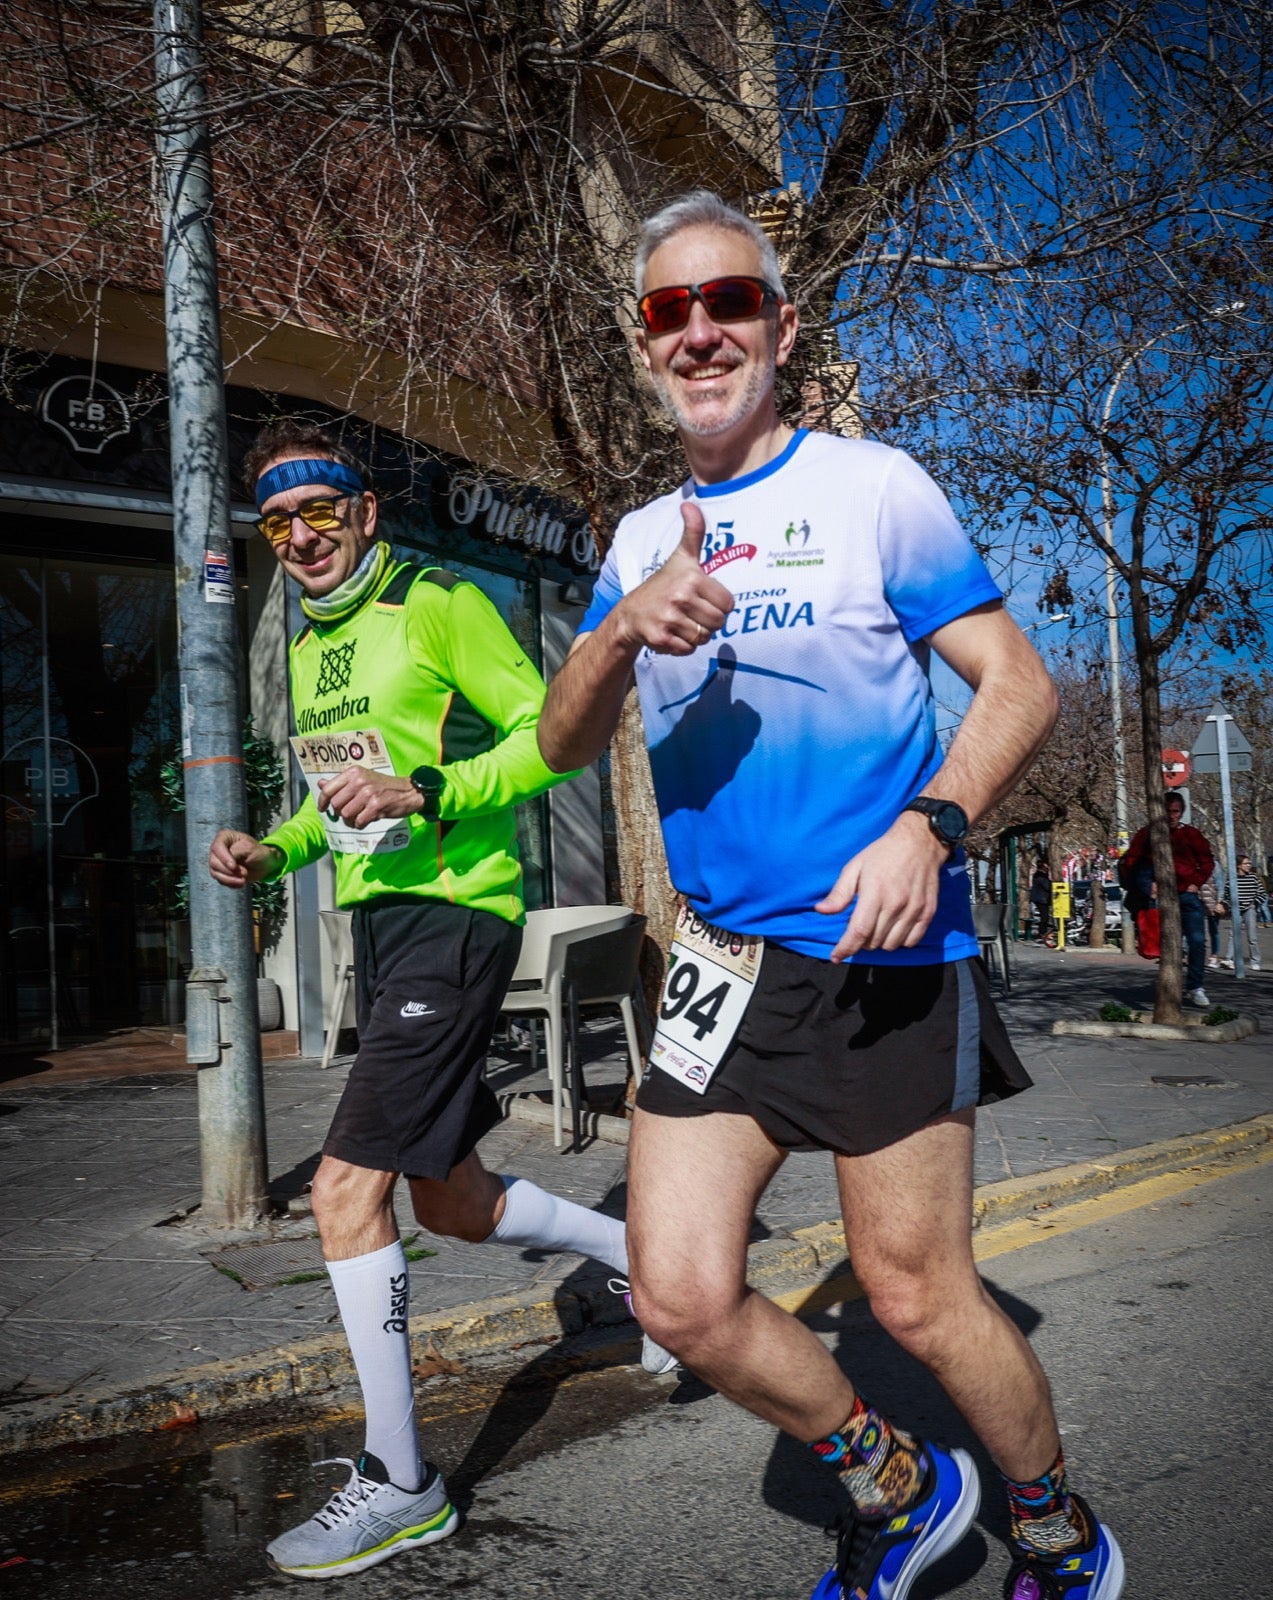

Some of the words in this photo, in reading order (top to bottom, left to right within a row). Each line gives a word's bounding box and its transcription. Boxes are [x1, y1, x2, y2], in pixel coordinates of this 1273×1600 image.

[703, 545, 749, 574] ERSARIO
[767, 548, 825, 560] Ayuntamiento
[775, 558, 824, 567] Maracena
[734, 588, 787, 600] TISMO
[711, 602, 815, 640] CENA
[297, 695, 370, 734] Alhambra
[310, 742, 364, 763] FONDO
[404, 1001, 427, 1014] NIKE
[660, 962, 732, 1041] 94
[389, 1273, 408, 1317] asics
